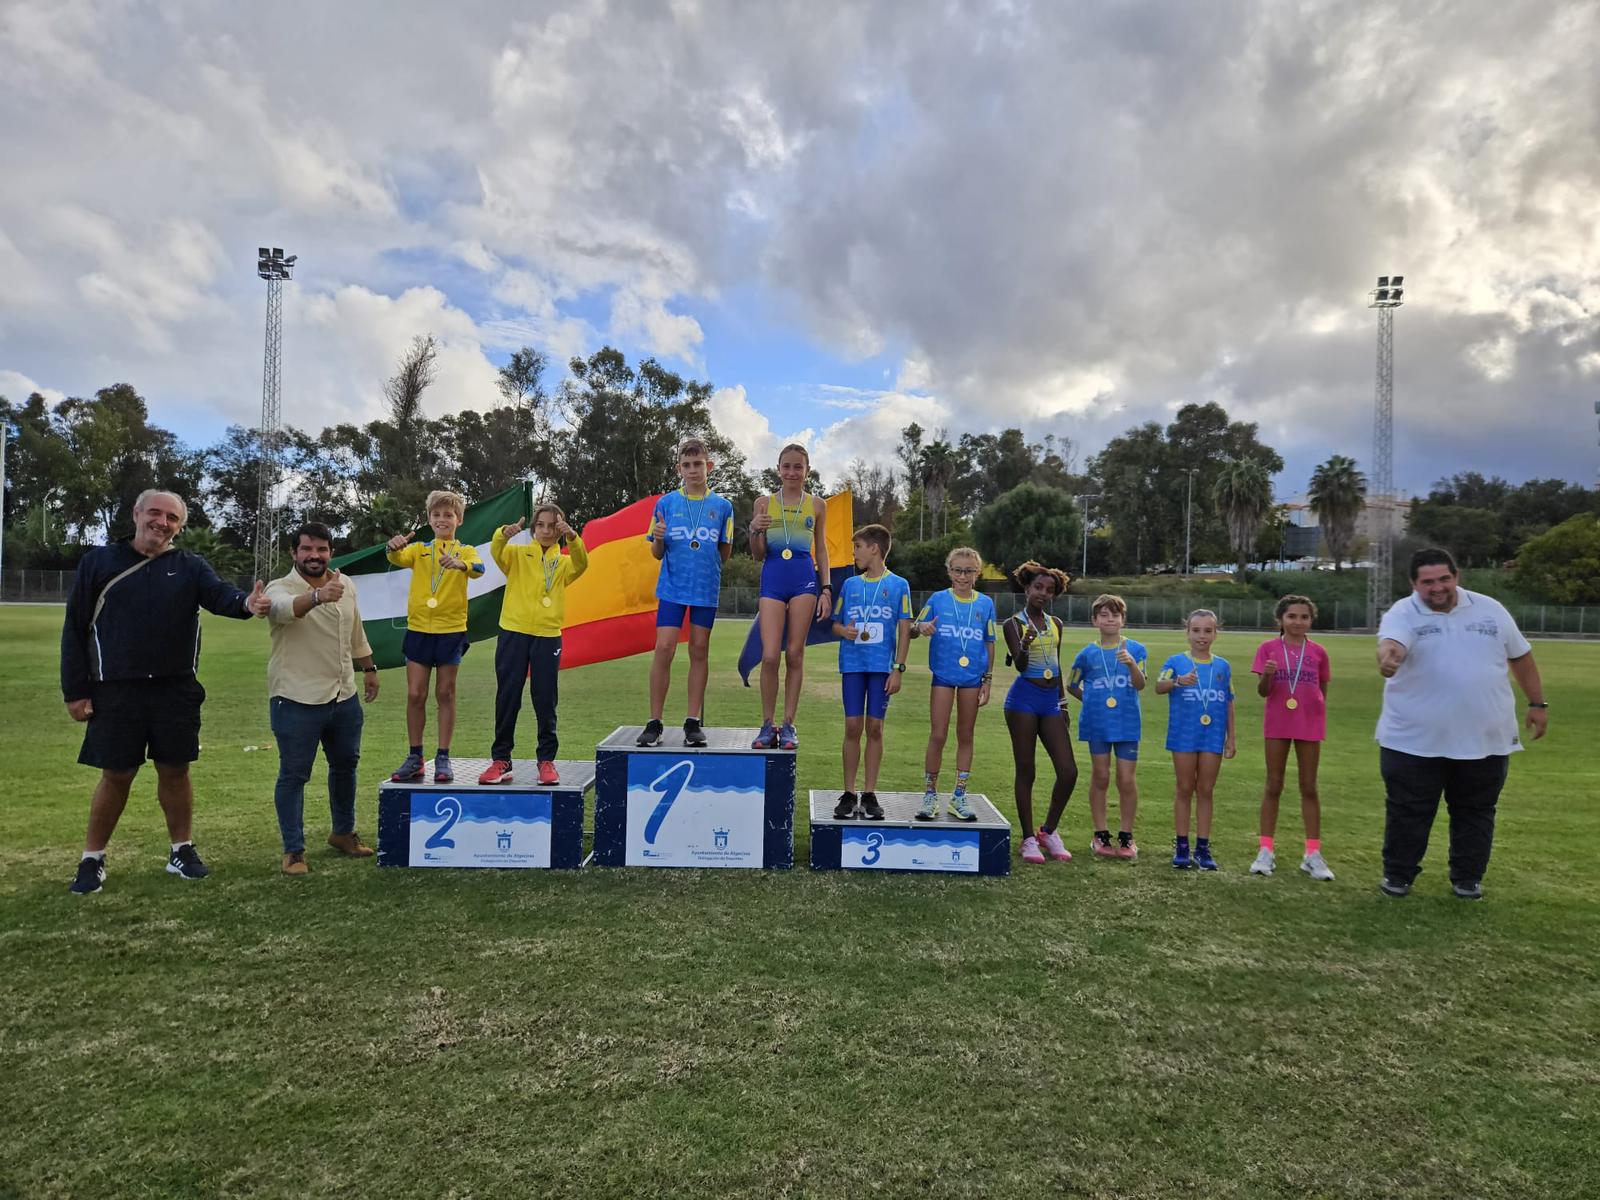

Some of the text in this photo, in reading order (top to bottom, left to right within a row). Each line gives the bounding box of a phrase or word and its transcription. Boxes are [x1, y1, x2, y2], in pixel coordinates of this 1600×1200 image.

[669, 526, 719, 542] EVOS
[847, 605, 893, 619] EVOS
[939, 624, 983, 641] EVOS
[1182, 688, 1226, 702] EVOS
[644, 760, 695, 844] 1
[425, 796, 462, 849] 2
[861, 832, 885, 865] 3
